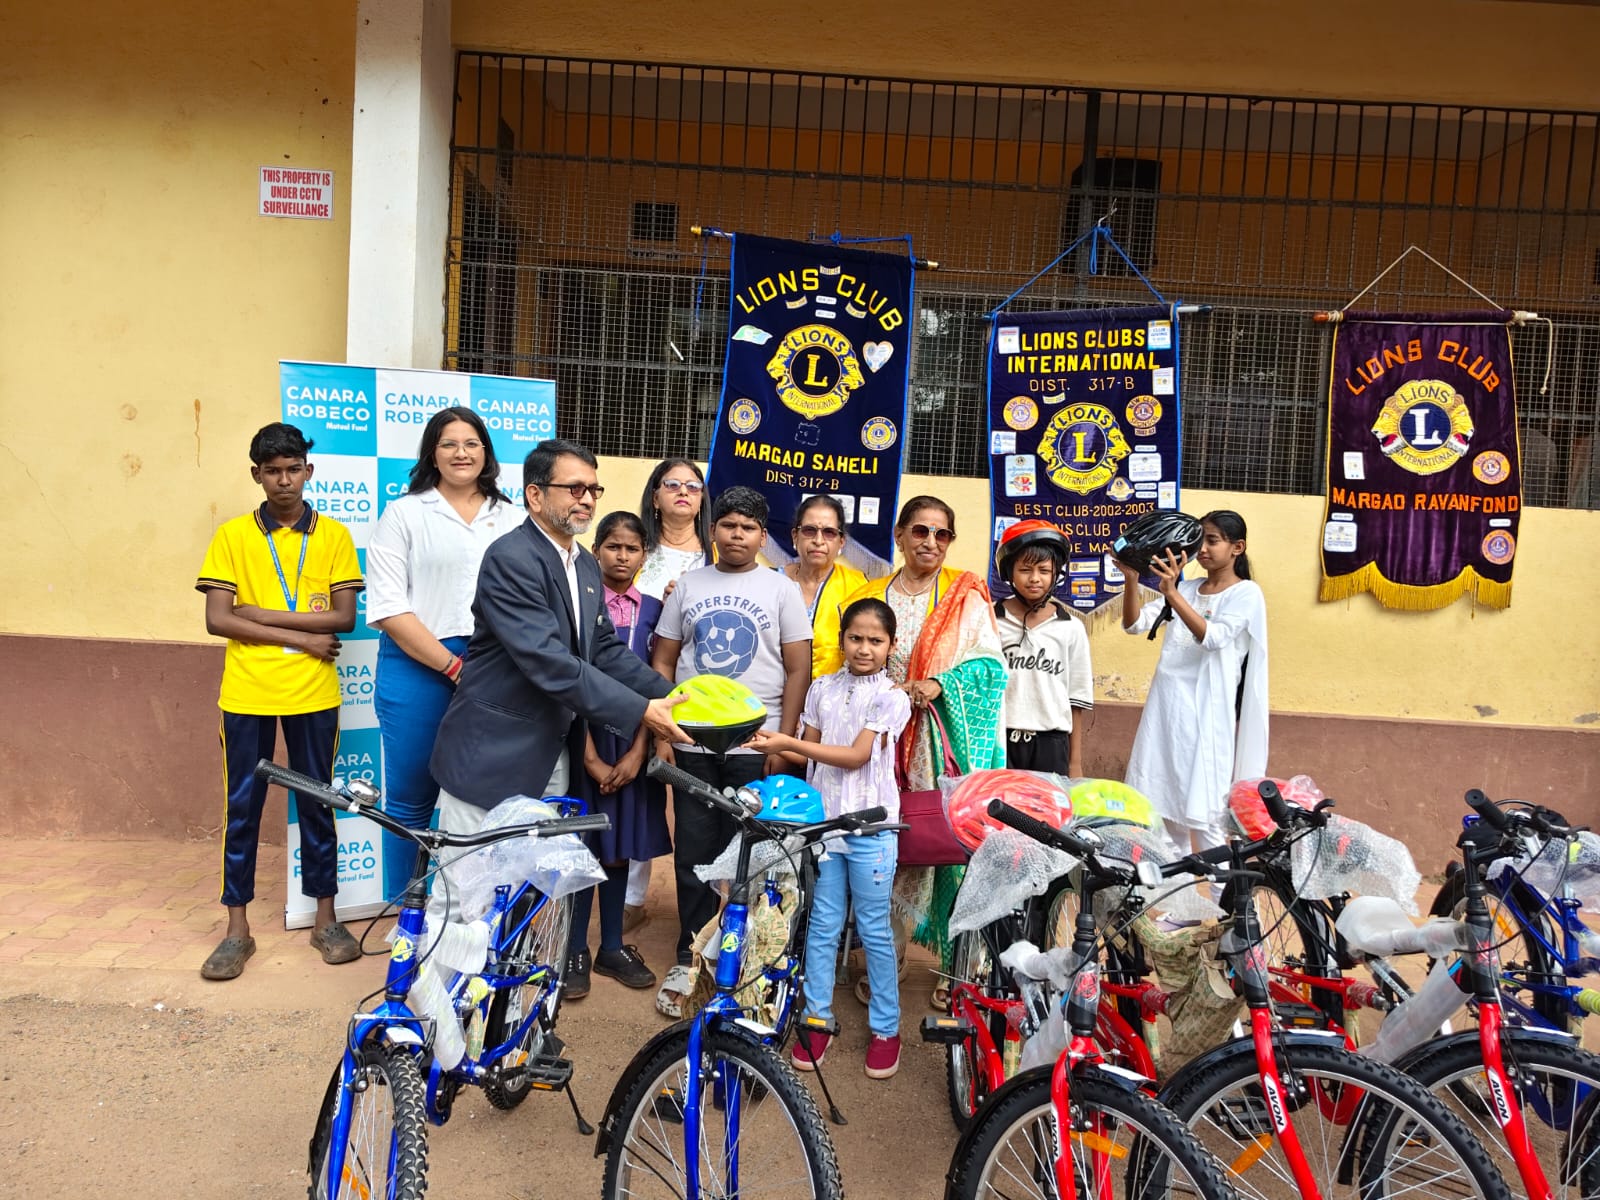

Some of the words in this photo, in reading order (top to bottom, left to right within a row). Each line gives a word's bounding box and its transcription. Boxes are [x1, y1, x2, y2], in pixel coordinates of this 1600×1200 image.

[263, 169, 281, 183] THIS
[283, 170, 322, 185] PROPERTY
[323, 173, 330, 186] IS
[271, 185, 298, 199] UNDER
[300, 187, 322, 201] CCTV
[263, 201, 329, 217] SURVEILLANCE
[736, 268, 820, 314] LIONS
[836, 274, 904, 332] CLUB
[790, 330, 848, 356] LIONS
[1021, 331, 1078, 351] LIONS
[1084, 329, 1146, 348] CLUBS
[803, 354, 829, 388] L
[1008, 352, 1160, 373] INTERNATIONAL
[1345, 339, 1423, 396] LIONS
[1437, 340, 1501, 393] CLUB
[1029, 378, 1071, 392] DIST.
[1399, 385, 1450, 404] LIONS
[286, 386, 369, 404] CANARA
[384, 392, 461, 409] CANARA
[788, 391, 838, 410] INTERNATIONAL
[287, 403, 371, 422] ROBECO
[384, 409, 436, 425] ROB
[477, 398, 550, 417] CANARA
[1057, 406, 1111, 427] LIONS
[326, 421, 351, 431] Mutual
[351, 423, 368, 432] Fund
[1409, 408, 1443, 446] L
[734, 439, 806, 469] MARGAO
[811, 453, 879, 475] SAHELI
[1072, 432, 1097, 463] L
[1396, 447, 1459, 468] INTERNATIONAL
[302, 480, 369, 495] ANARA
[765, 469, 795, 487] DIST.
[798, 476, 840, 491] 317-B
[1056, 472, 1108, 487] INTERNATIONAL
[304, 498, 371, 512] BECO
[1014, 503, 1052, 516] BEST
[1333, 487, 1405, 511] MARGAO
[1414, 493, 1519, 513] RAVANFOND
[1075, 523, 1111, 537] CLUB
[685, 595, 772, 631] SUPERSTRIKER
[336, 665, 372, 678] ARA
[334, 752, 373, 767] ARA
[337, 874, 357, 883] utual
[1267, 1085, 1285, 1127] AVON
[1490, 1079, 1509, 1119] AVON
[1051, 1114, 1060, 1158] AVON
